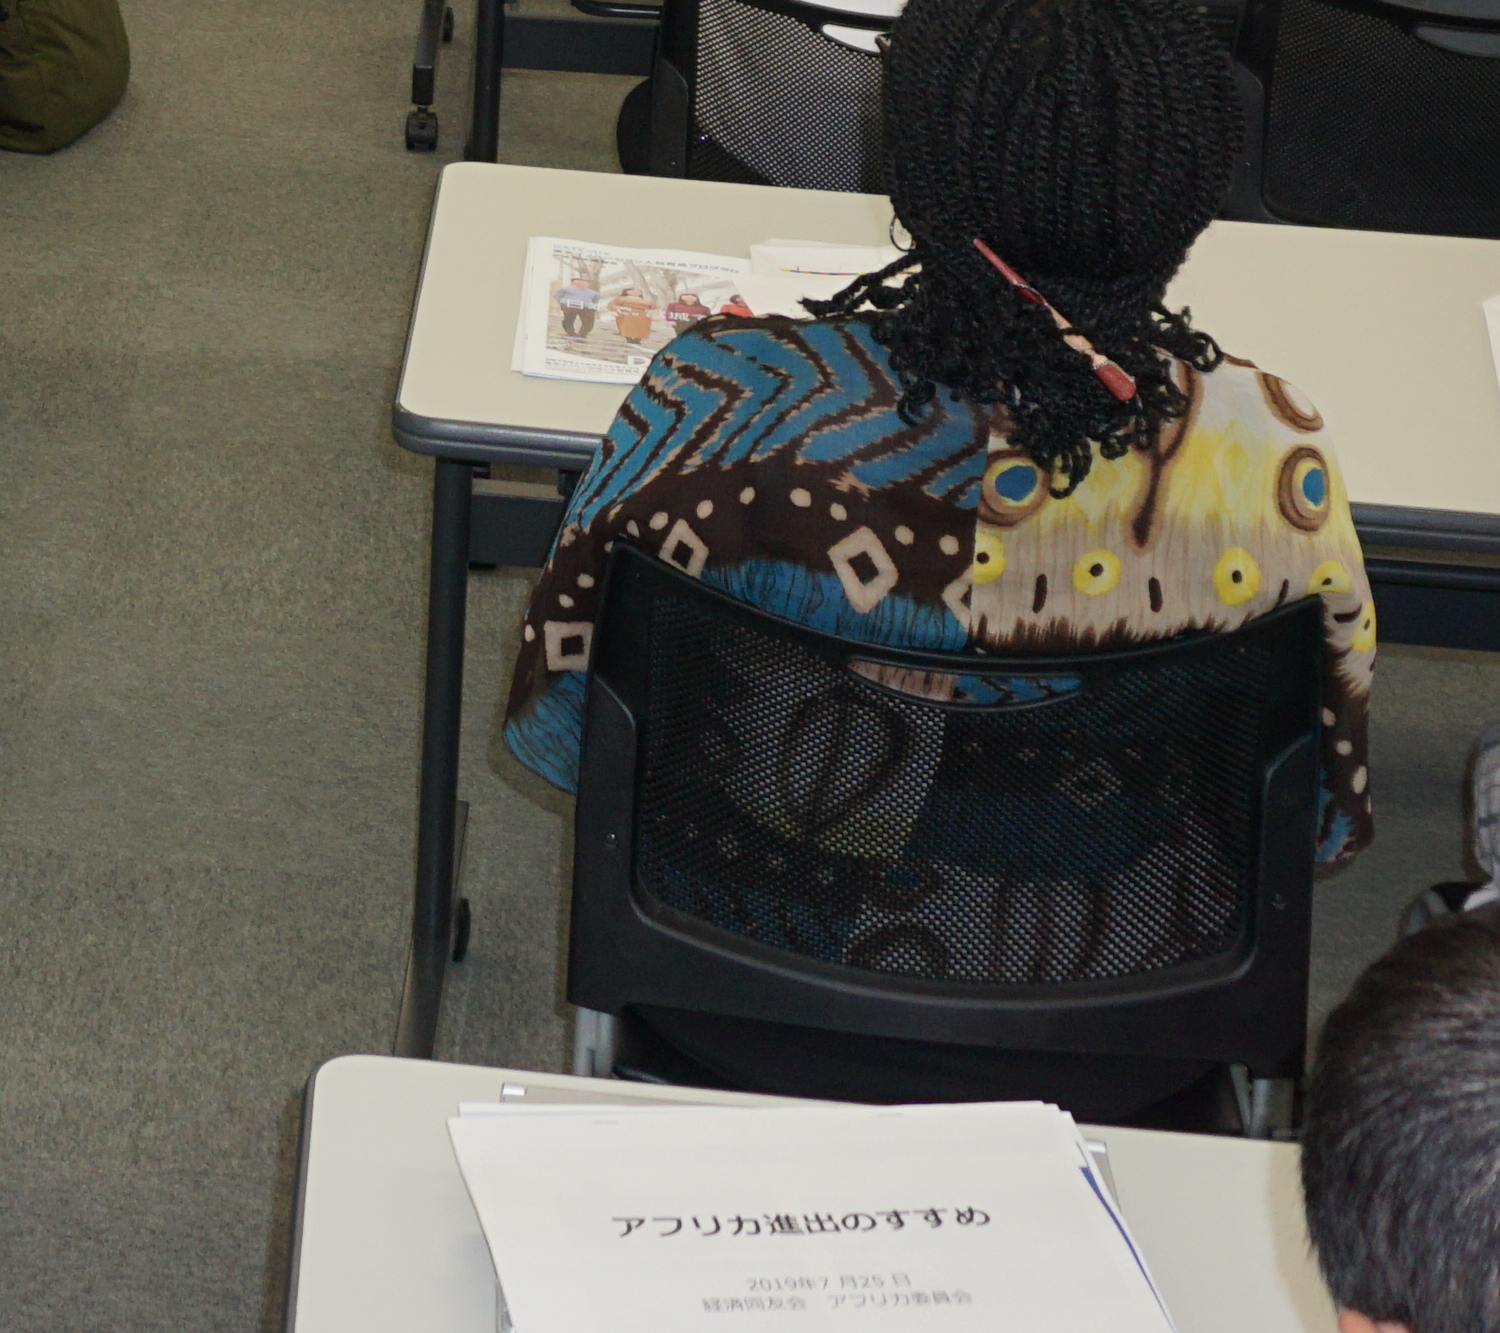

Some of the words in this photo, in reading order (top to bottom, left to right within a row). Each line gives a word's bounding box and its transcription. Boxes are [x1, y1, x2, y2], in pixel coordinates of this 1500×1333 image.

[611, 1204, 992, 1238] アフリカ進出のすすめ
